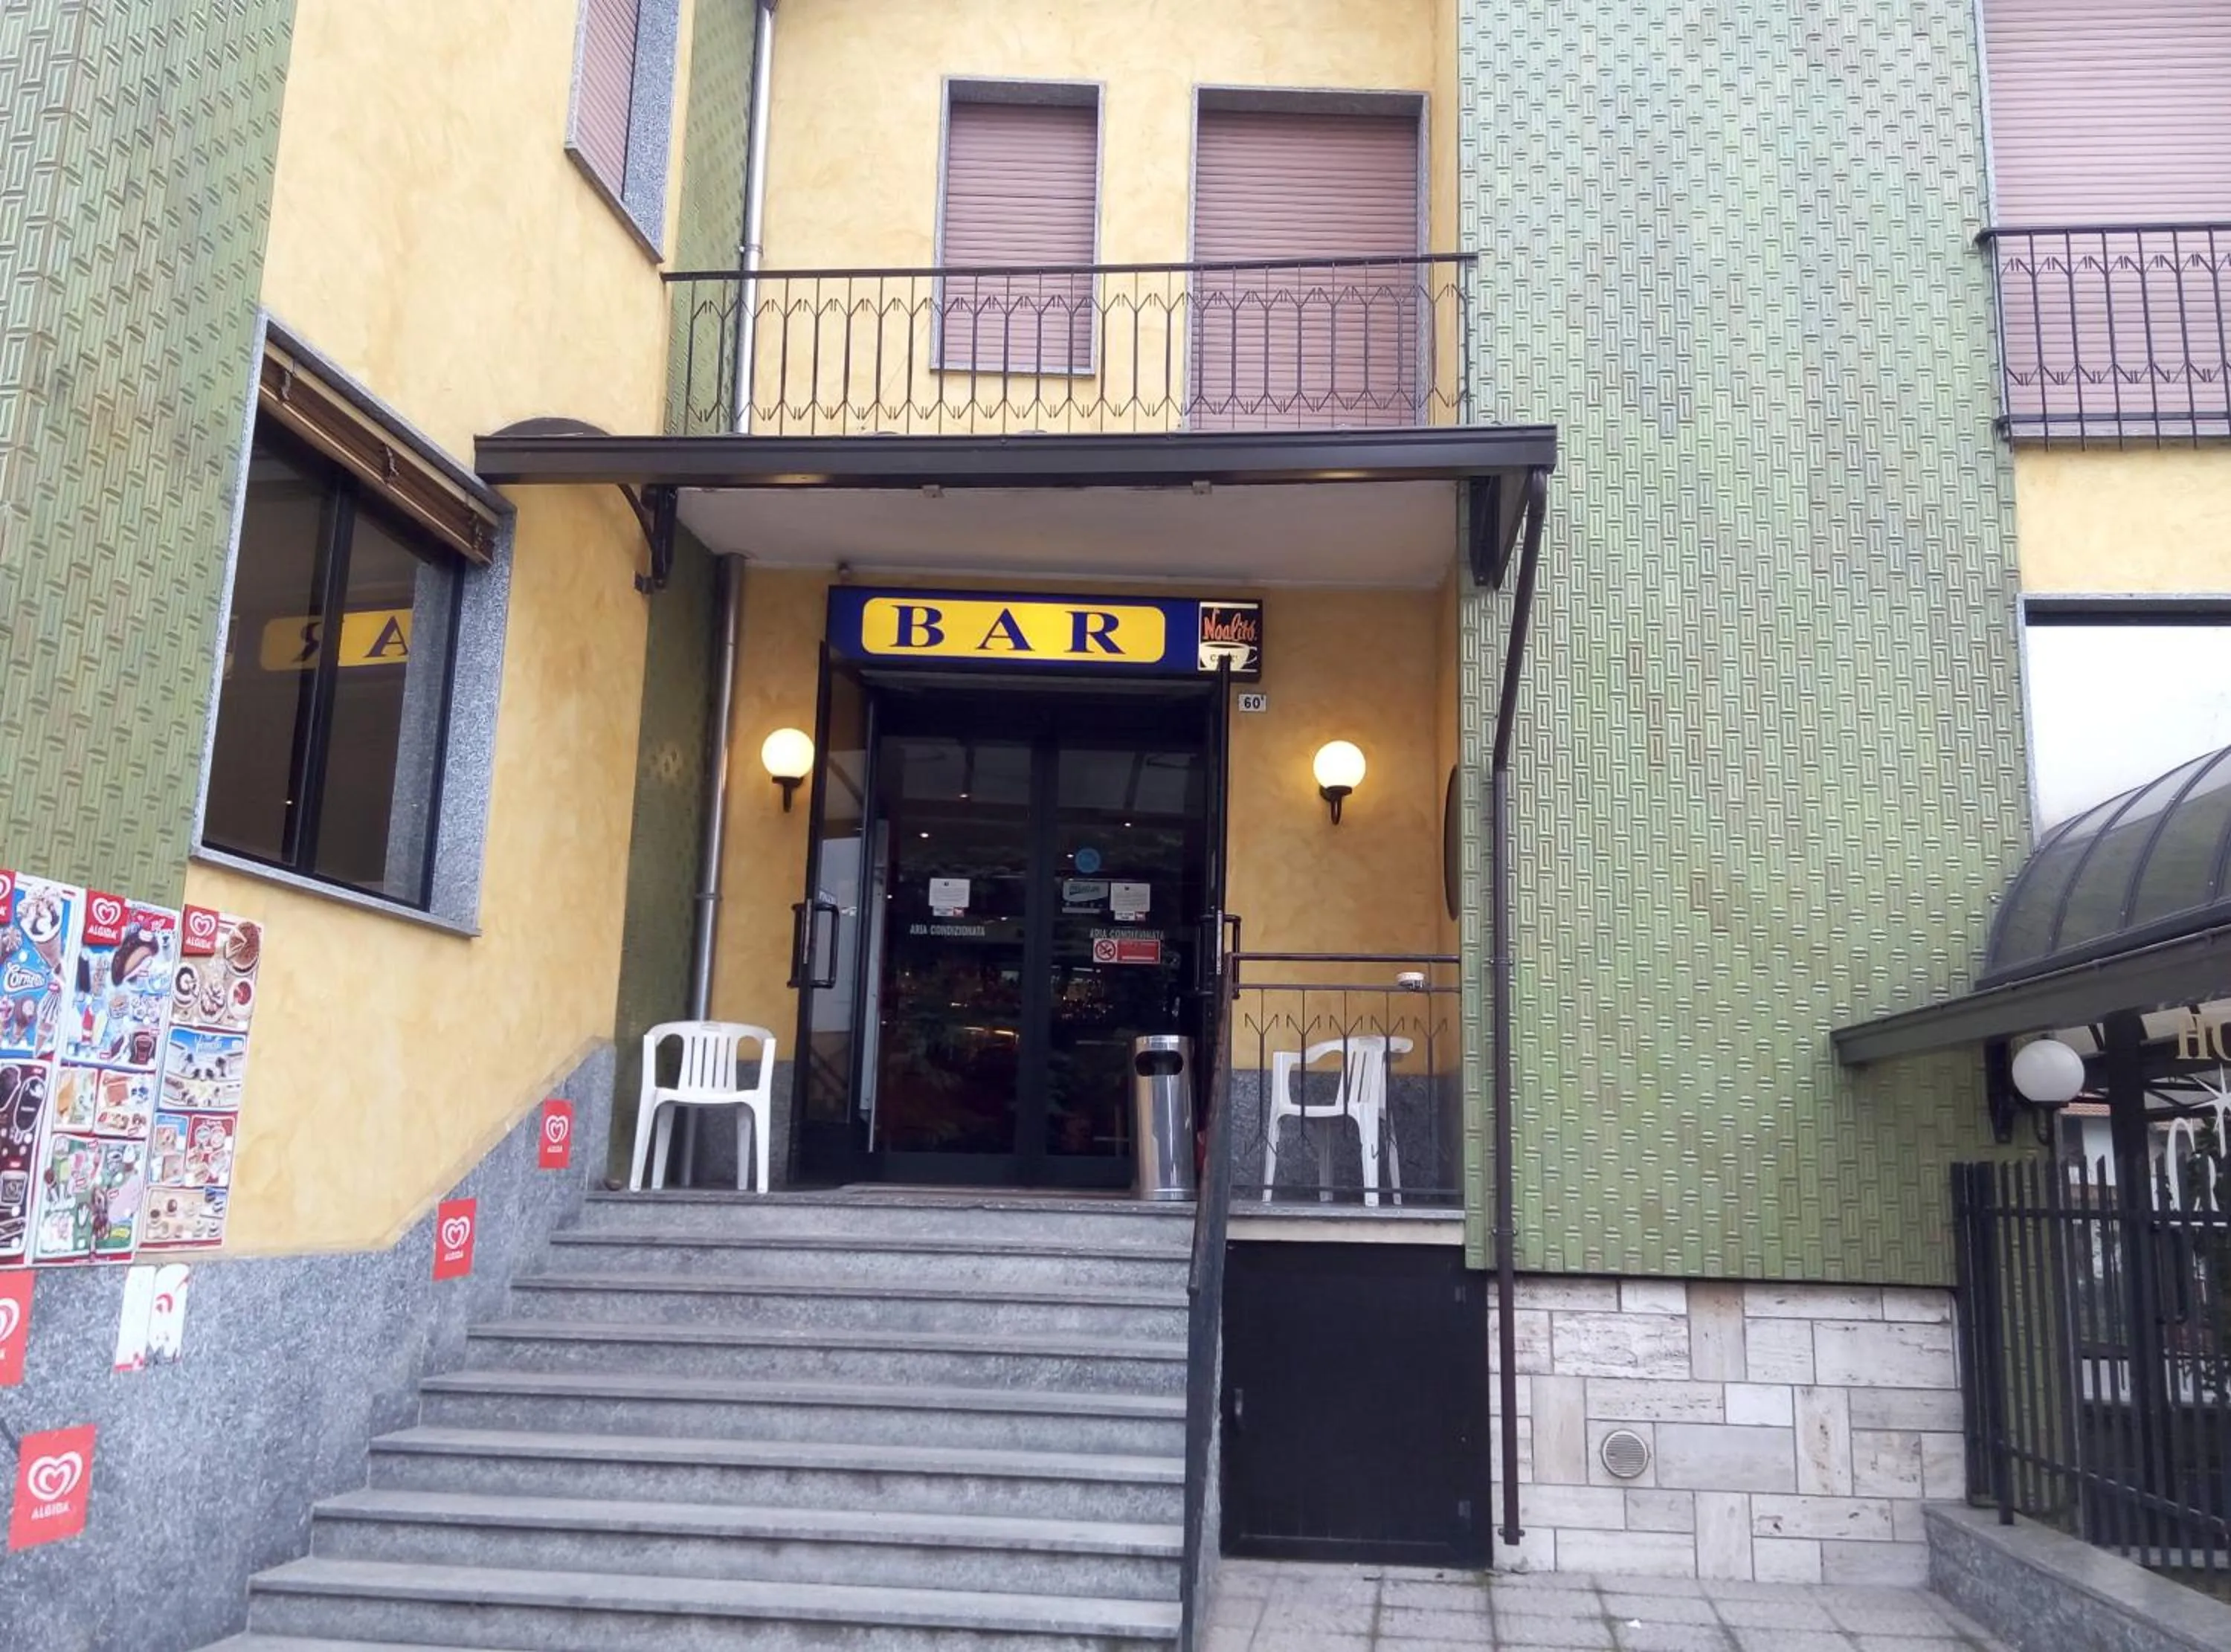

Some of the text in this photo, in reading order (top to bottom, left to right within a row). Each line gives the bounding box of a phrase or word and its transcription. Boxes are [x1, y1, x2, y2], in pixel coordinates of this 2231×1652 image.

[890, 604, 1126, 654] BAR
[910, 923, 985, 936] ARIA CONDIZIONATA
